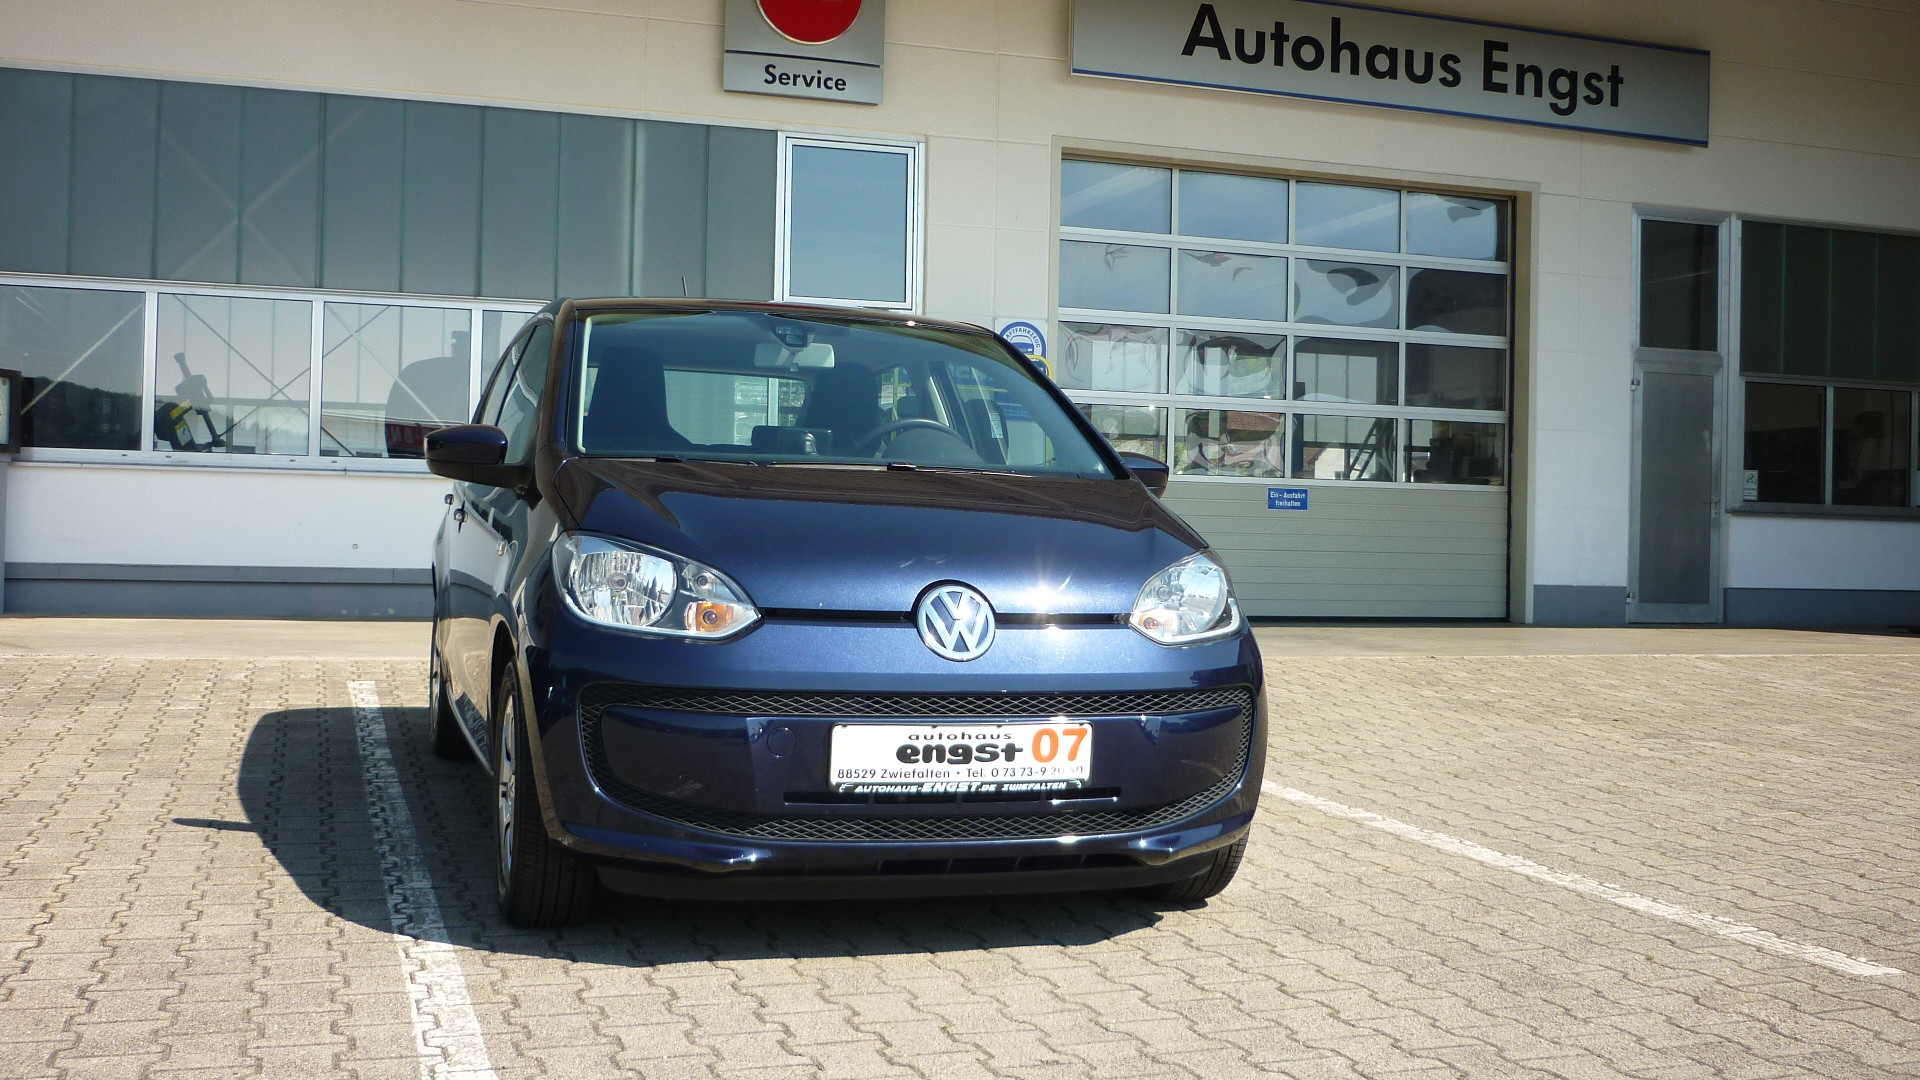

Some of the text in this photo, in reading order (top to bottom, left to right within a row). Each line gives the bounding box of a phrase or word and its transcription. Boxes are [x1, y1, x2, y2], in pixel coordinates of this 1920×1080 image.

[1181, 3, 1624, 116] Autohaus Engst
[763, 64, 847, 92] Service
[896, 728, 1088, 764] engst 07
[908, 732, 1012, 741] autohaus
[837, 768, 877, 779] 88529
[880, 768, 950, 779] Zwiefalten
[966, 768, 987, 778] Tel.
